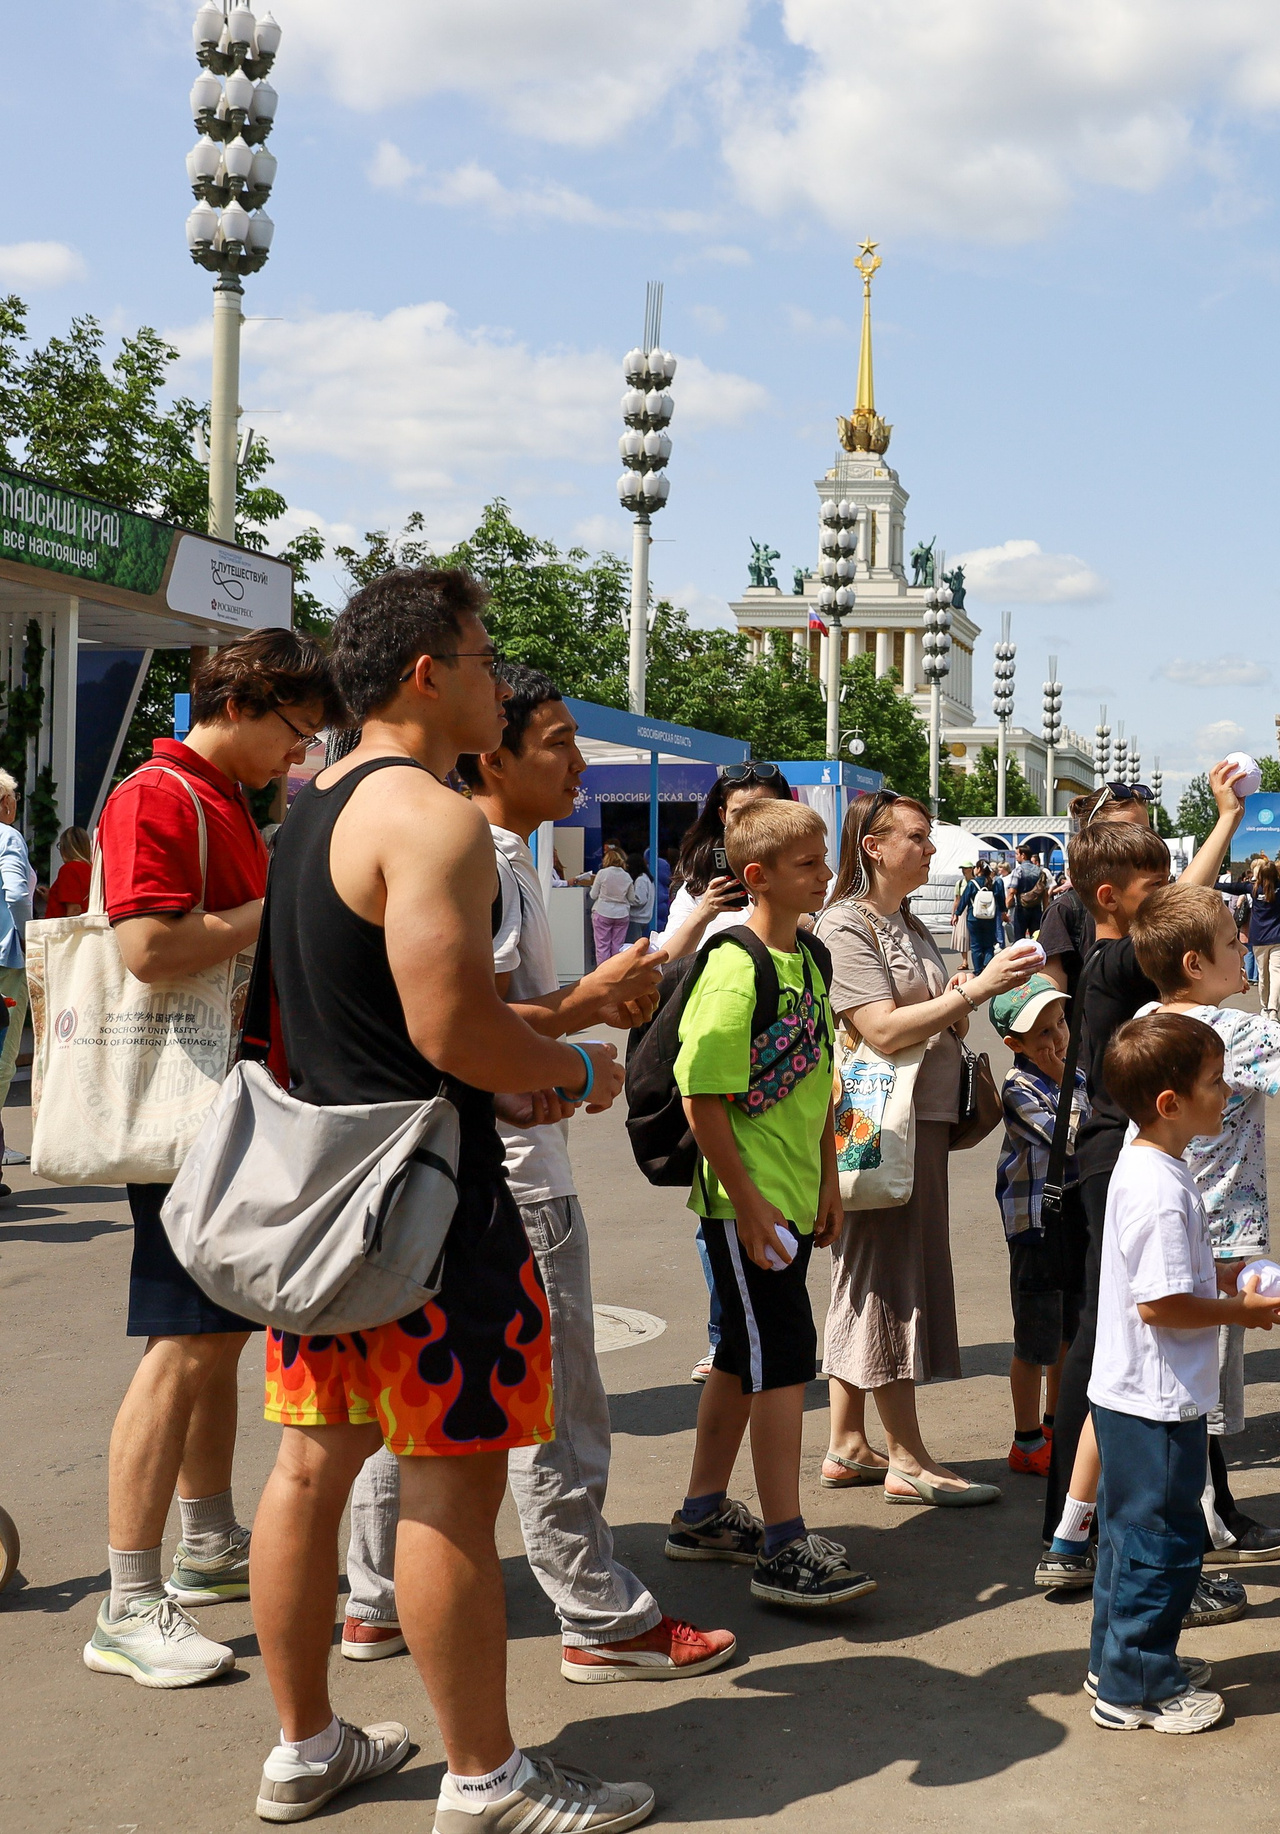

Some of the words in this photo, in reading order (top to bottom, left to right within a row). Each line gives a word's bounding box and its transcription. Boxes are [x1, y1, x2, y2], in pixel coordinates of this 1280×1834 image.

[82, 507, 120, 548] КРАЙ
[3, 529, 25, 550] все
[29, 536, 97, 570] настоящее!
[594, 792, 683, 802] НОВОСИБИСКАЯ
[850, 900, 882, 928] HAEL
[105, 1011, 196, 1023] 苏州大学外国语学院
[99, 1026, 146, 1035] SOOCHOW
[149, 1027, 200, 1035] UNIVERSITY
[73, 1037, 108, 1046] SCHOOL
[110, 1038, 120, 1046] OF
[120, 1037, 161, 1046] FOREIGN
[164, 1038, 217, 1047] LANGUAGES
[462, 1771, 508, 1792] ATHLETIC
